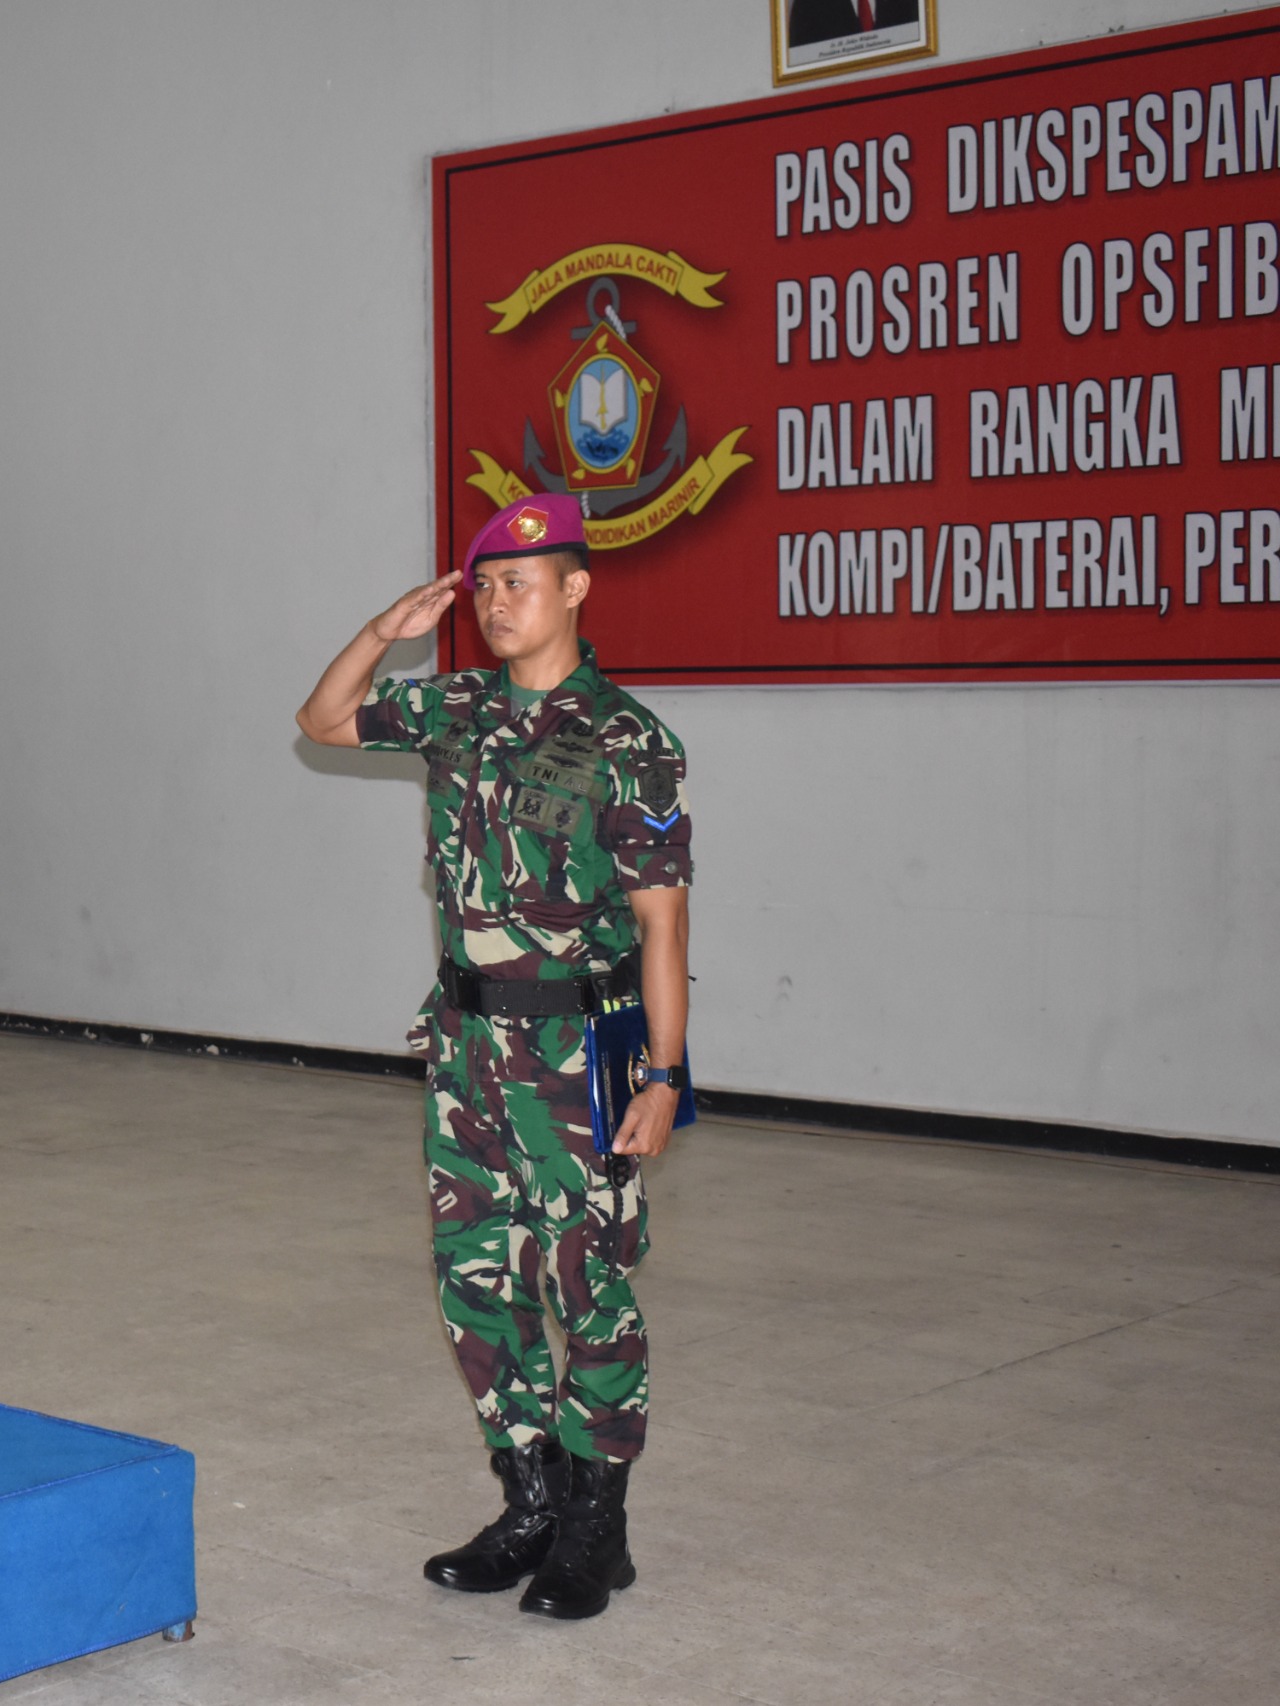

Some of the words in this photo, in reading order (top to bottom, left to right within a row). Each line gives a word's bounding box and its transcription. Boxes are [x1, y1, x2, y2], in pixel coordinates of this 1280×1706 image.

[775, 133, 912, 237] PASIS
[947, 75, 1280, 214] DIKSPESPAM
[531, 271, 563, 304] JALA
[565, 253, 632, 279] MANDALA
[636, 255, 678, 287] CAKTI
[776, 251, 1020, 364] PROSREN
[777, 394, 934, 490] DALAM
[970, 373, 1181, 478] RANGKA
[648, 477, 702, 527] MARINIR
[778, 514, 1170, 618] KOMPI/BATERAI,
[532, 765, 559, 782] TNI
[564, 776, 587, 793] AL
